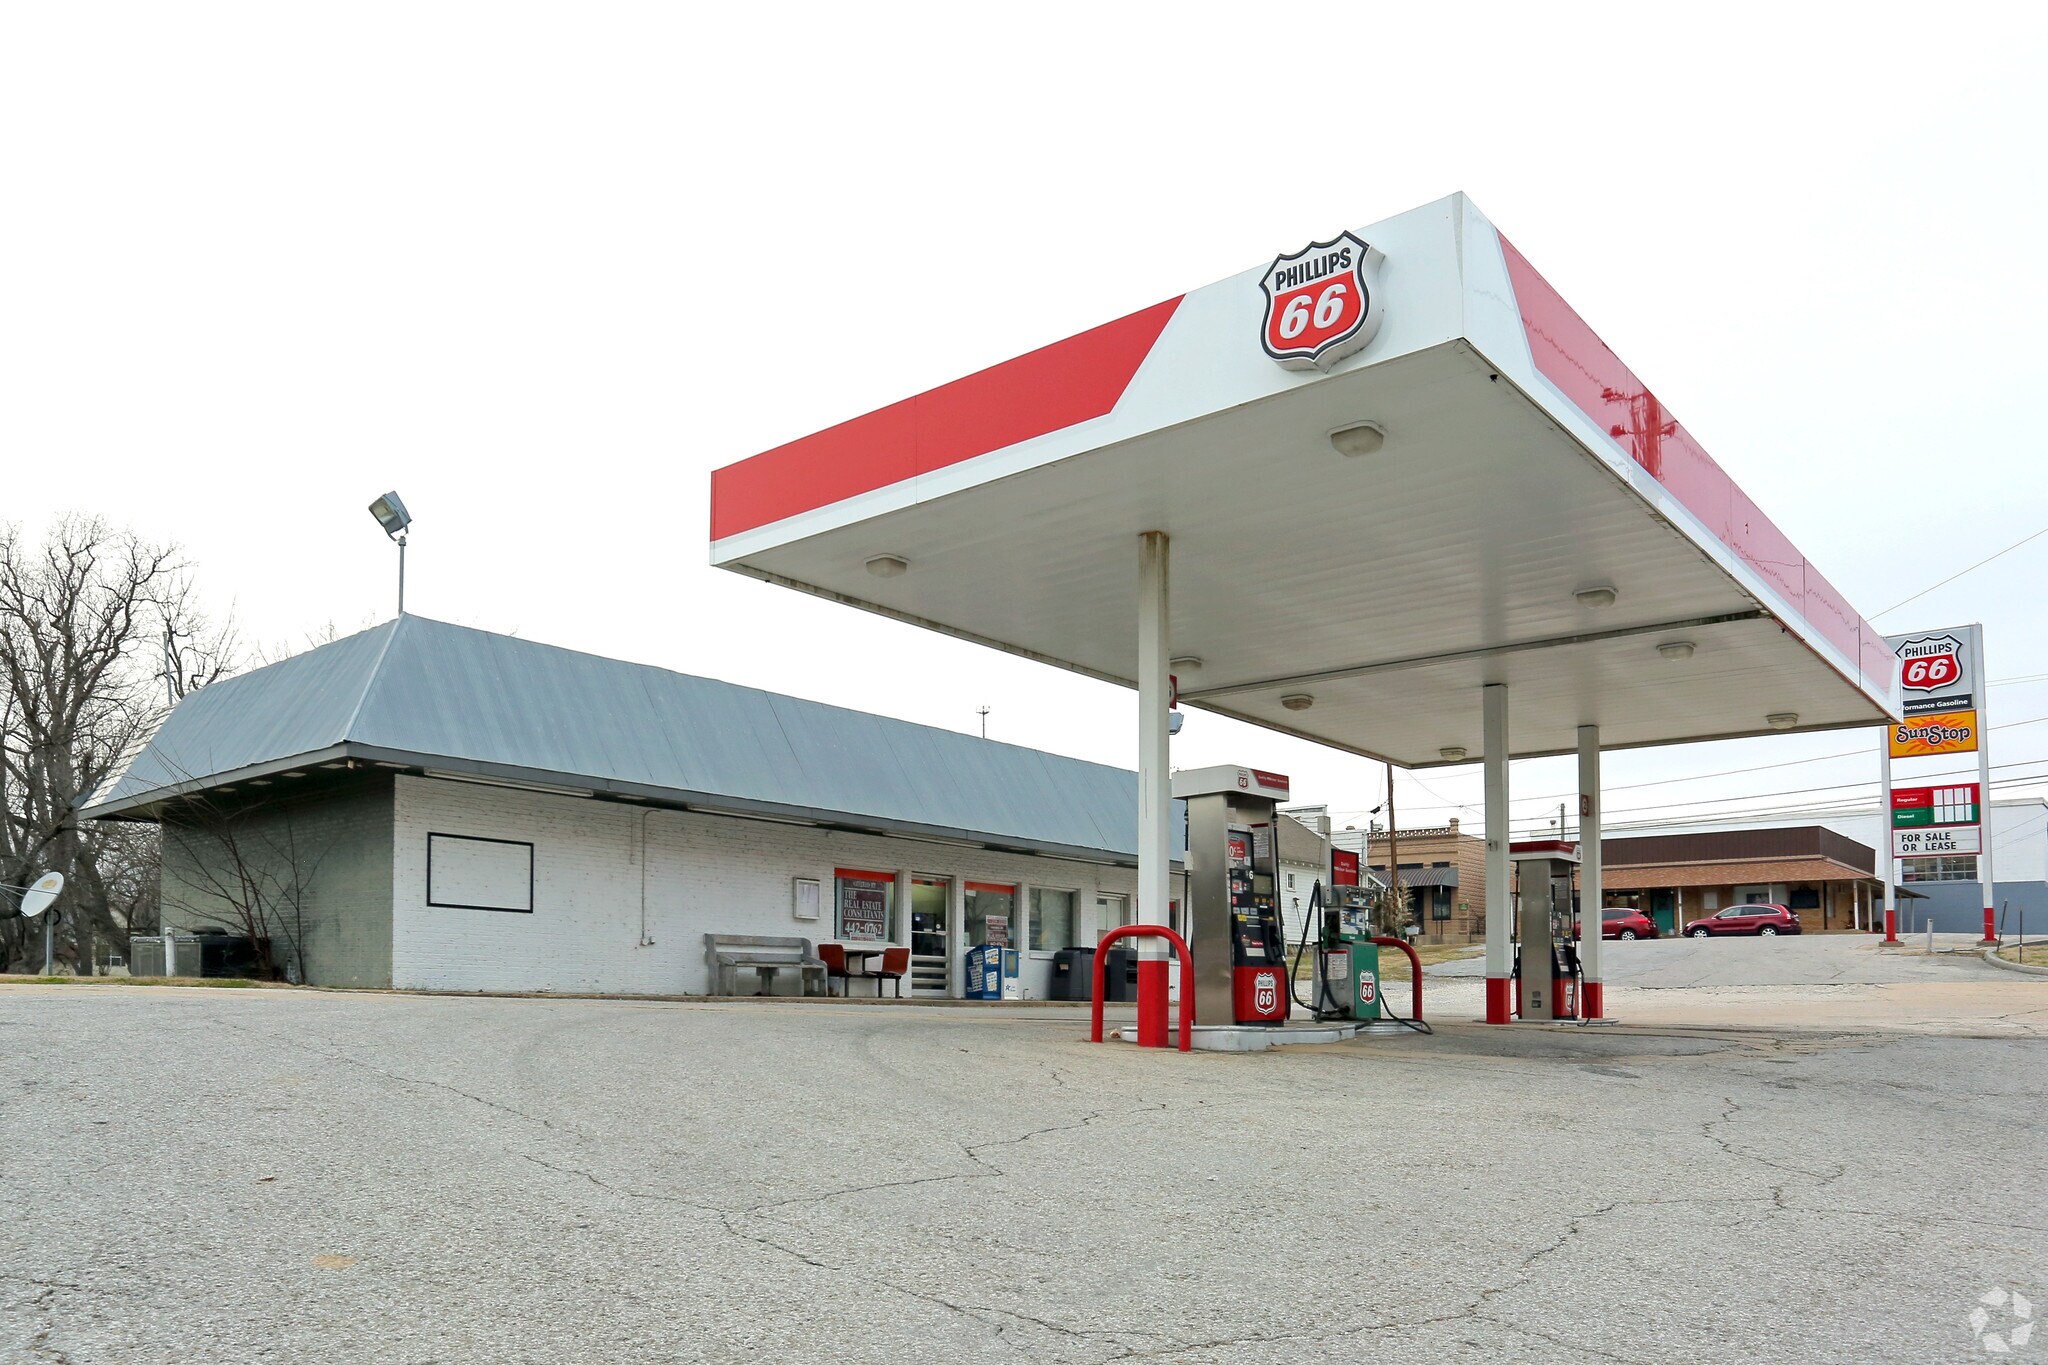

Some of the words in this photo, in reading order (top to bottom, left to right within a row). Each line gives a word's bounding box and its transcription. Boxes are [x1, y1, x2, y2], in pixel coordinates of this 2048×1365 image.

[1275, 247, 1351, 291] PHILLIPS
[1279, 283, 1347, 339] 66
[1905, 642, 1952, 658] PHILLIPS
[1908, 658, 1950, 682] 66
[1937, 699, 1968, 707] Gasoline
[1896, 725, 1970, 744] SunStop
[1901, 834, 1920, 842] FOR
[1925, 832, 1951, 841] SALE
[1902, 843, 1917, 851] OR
[1925, 841, 1956, 851] LEASE
[1249, 870, 1254, 880] 6
[844, 891, 857, 899] THE
[844, 900, 860, 908] REAL
[862, 901, 882, 910] ESTATE
[844, 909, 884, 919] CONSULTANTS
[845, 922, 882, 934] 442-0762
[1257, 979, 1274, 987] PHILLIPS
[1362, 984, 1373, 998] 66
[1259, 991, 1273, 1006] 66
